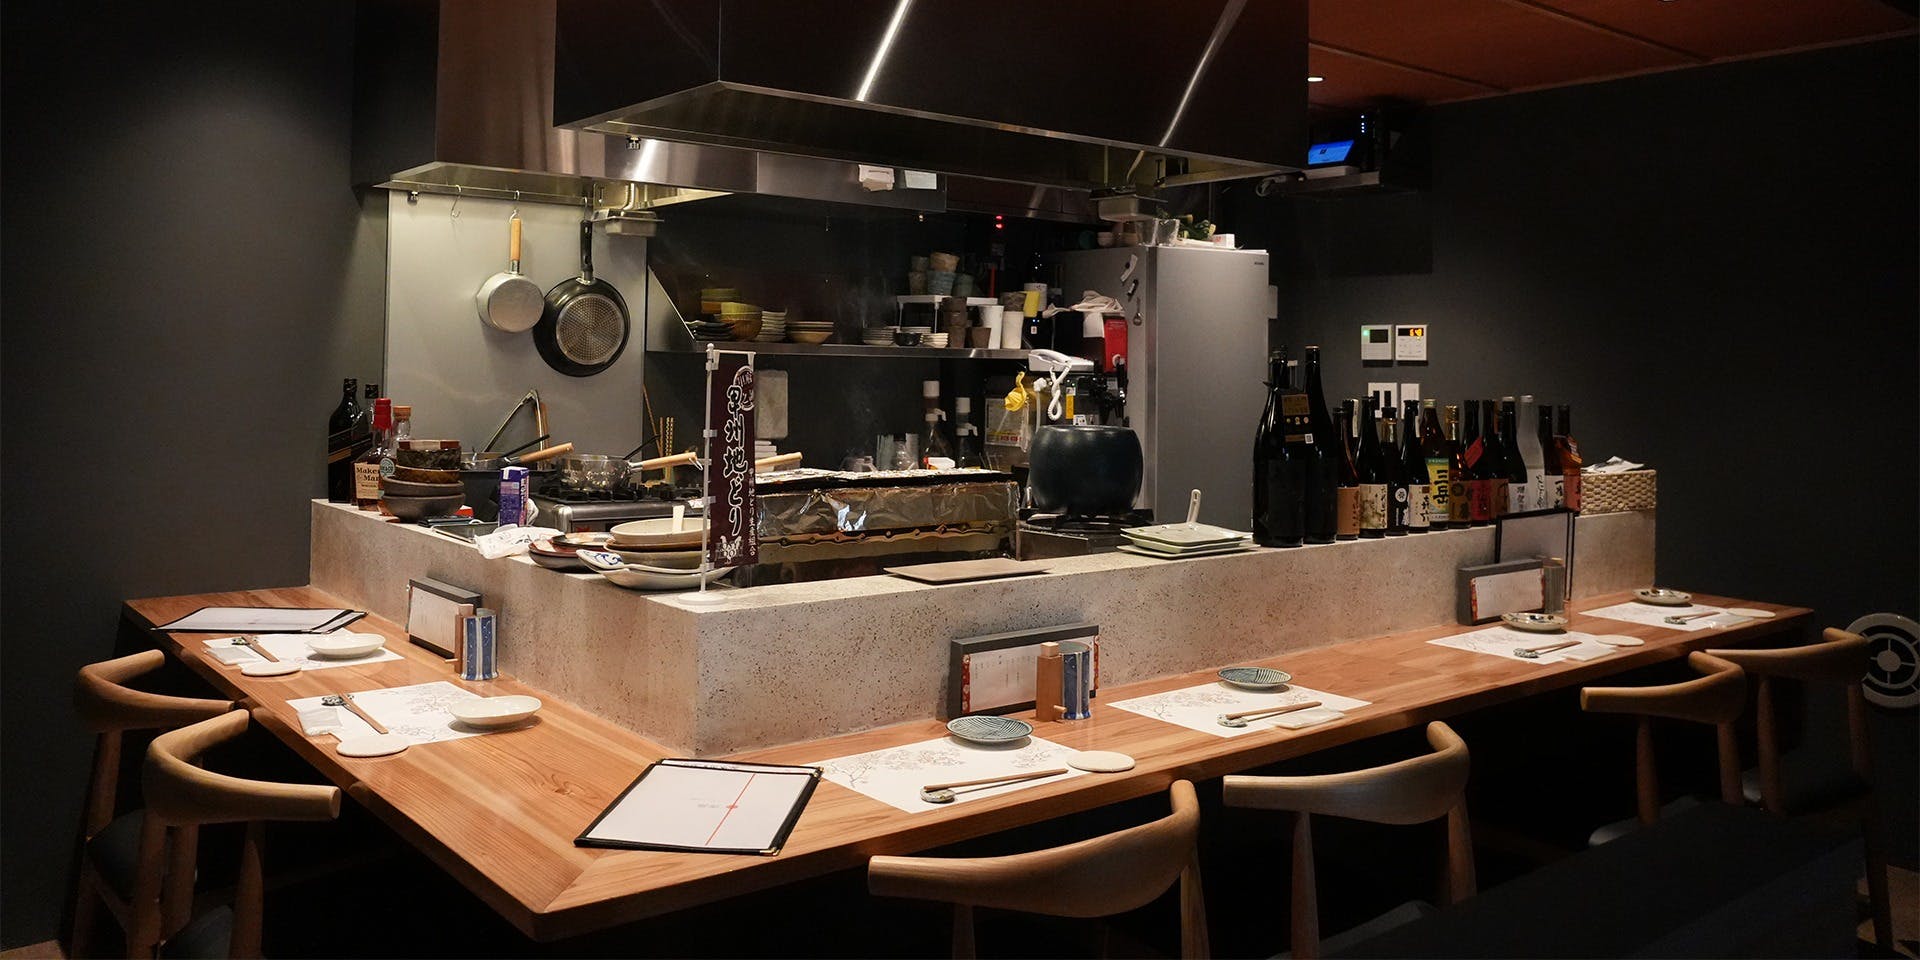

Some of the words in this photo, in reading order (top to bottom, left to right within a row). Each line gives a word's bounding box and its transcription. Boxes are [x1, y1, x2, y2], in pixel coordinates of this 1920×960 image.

[723, 385, 748, 537] 甲州地どり
[1433, 469, 1449, 504] 三岳
